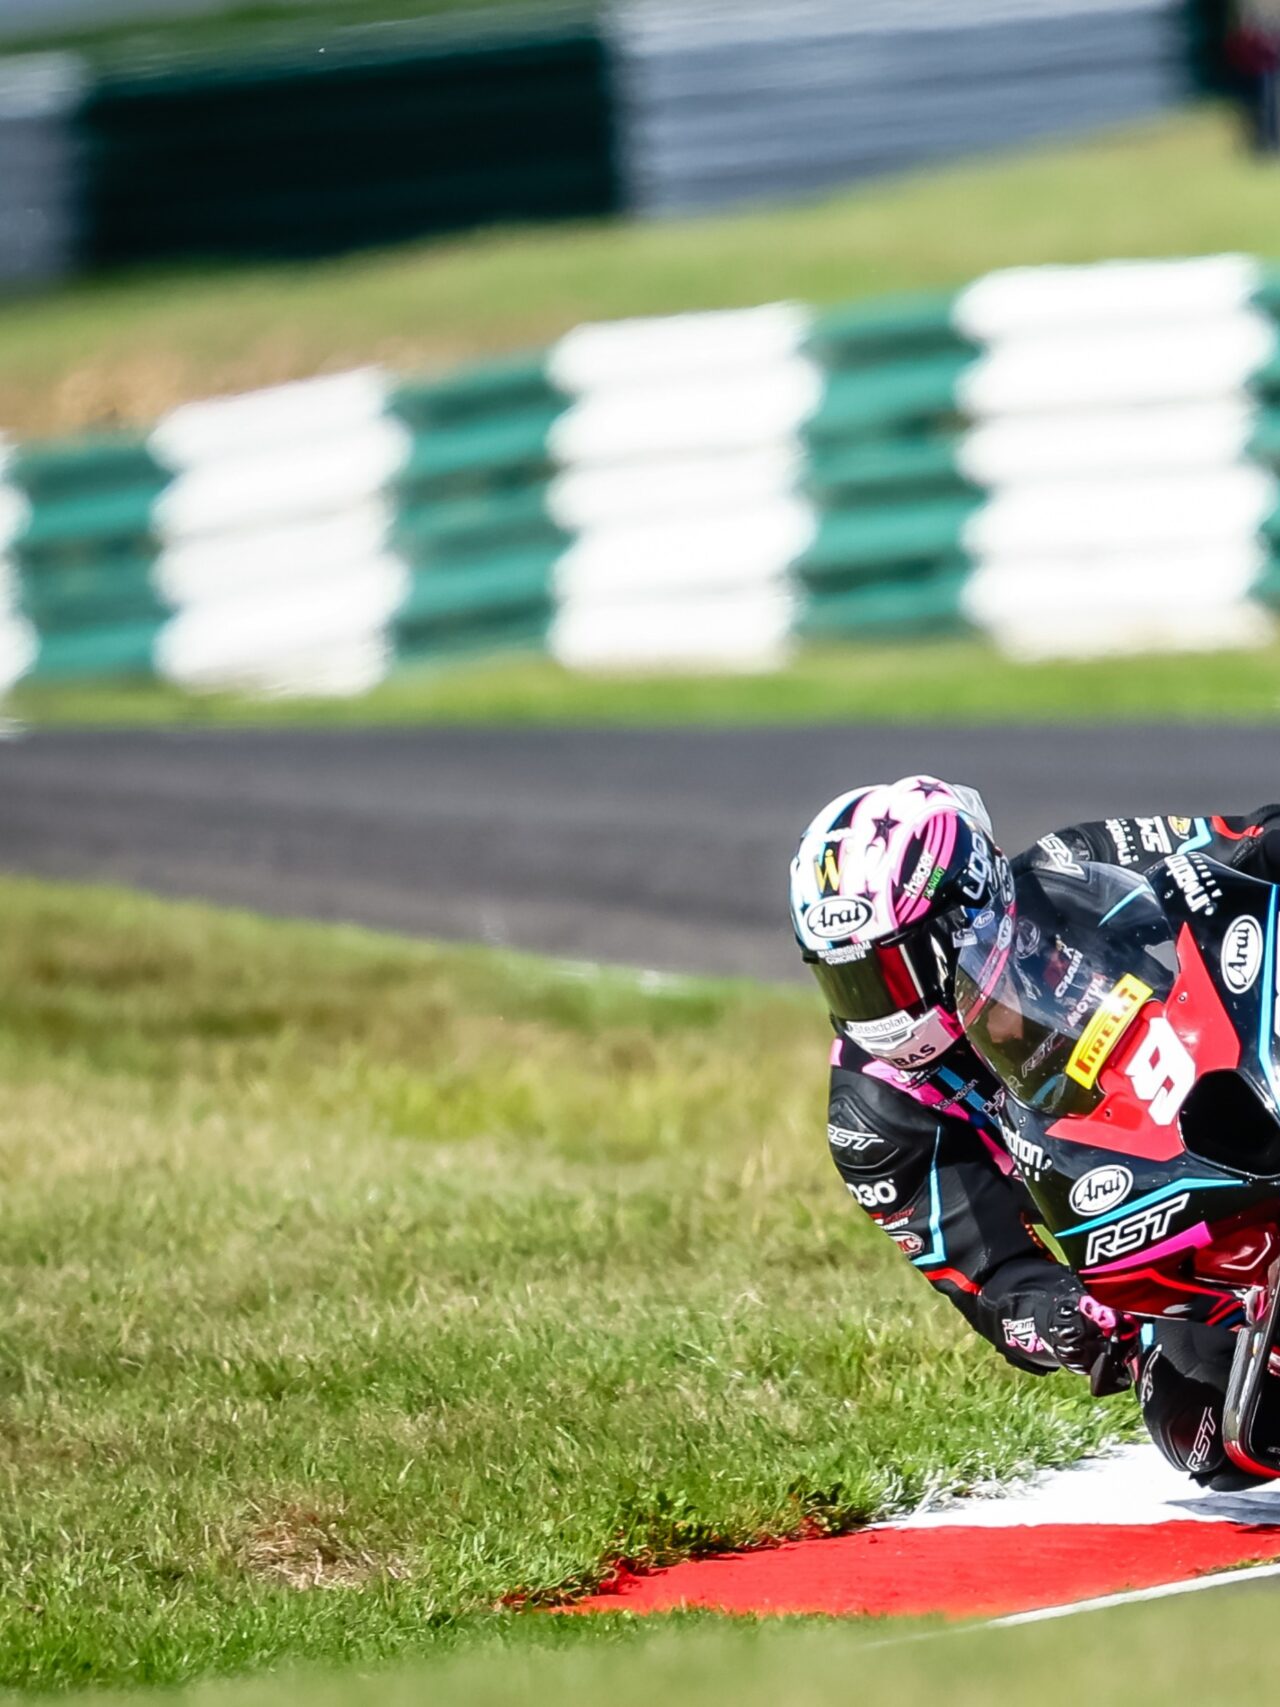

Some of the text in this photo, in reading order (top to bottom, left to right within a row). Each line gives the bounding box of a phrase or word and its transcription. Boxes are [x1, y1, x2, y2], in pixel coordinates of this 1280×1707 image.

[809, 900, 864, 934] Arai
[1227, 925, 1251, 985] Arai
[853, 1014, 909, 1036] Steadplan
[1075, 986, 1139, 1076] PIRELI
[1124, 1016, 1196, 1126] 9
[1075, 1169, 1122, 1209] Arai
[1085, 1193, 1190, 1266] RST
[1186, 1407, 1216, 1472] RST
